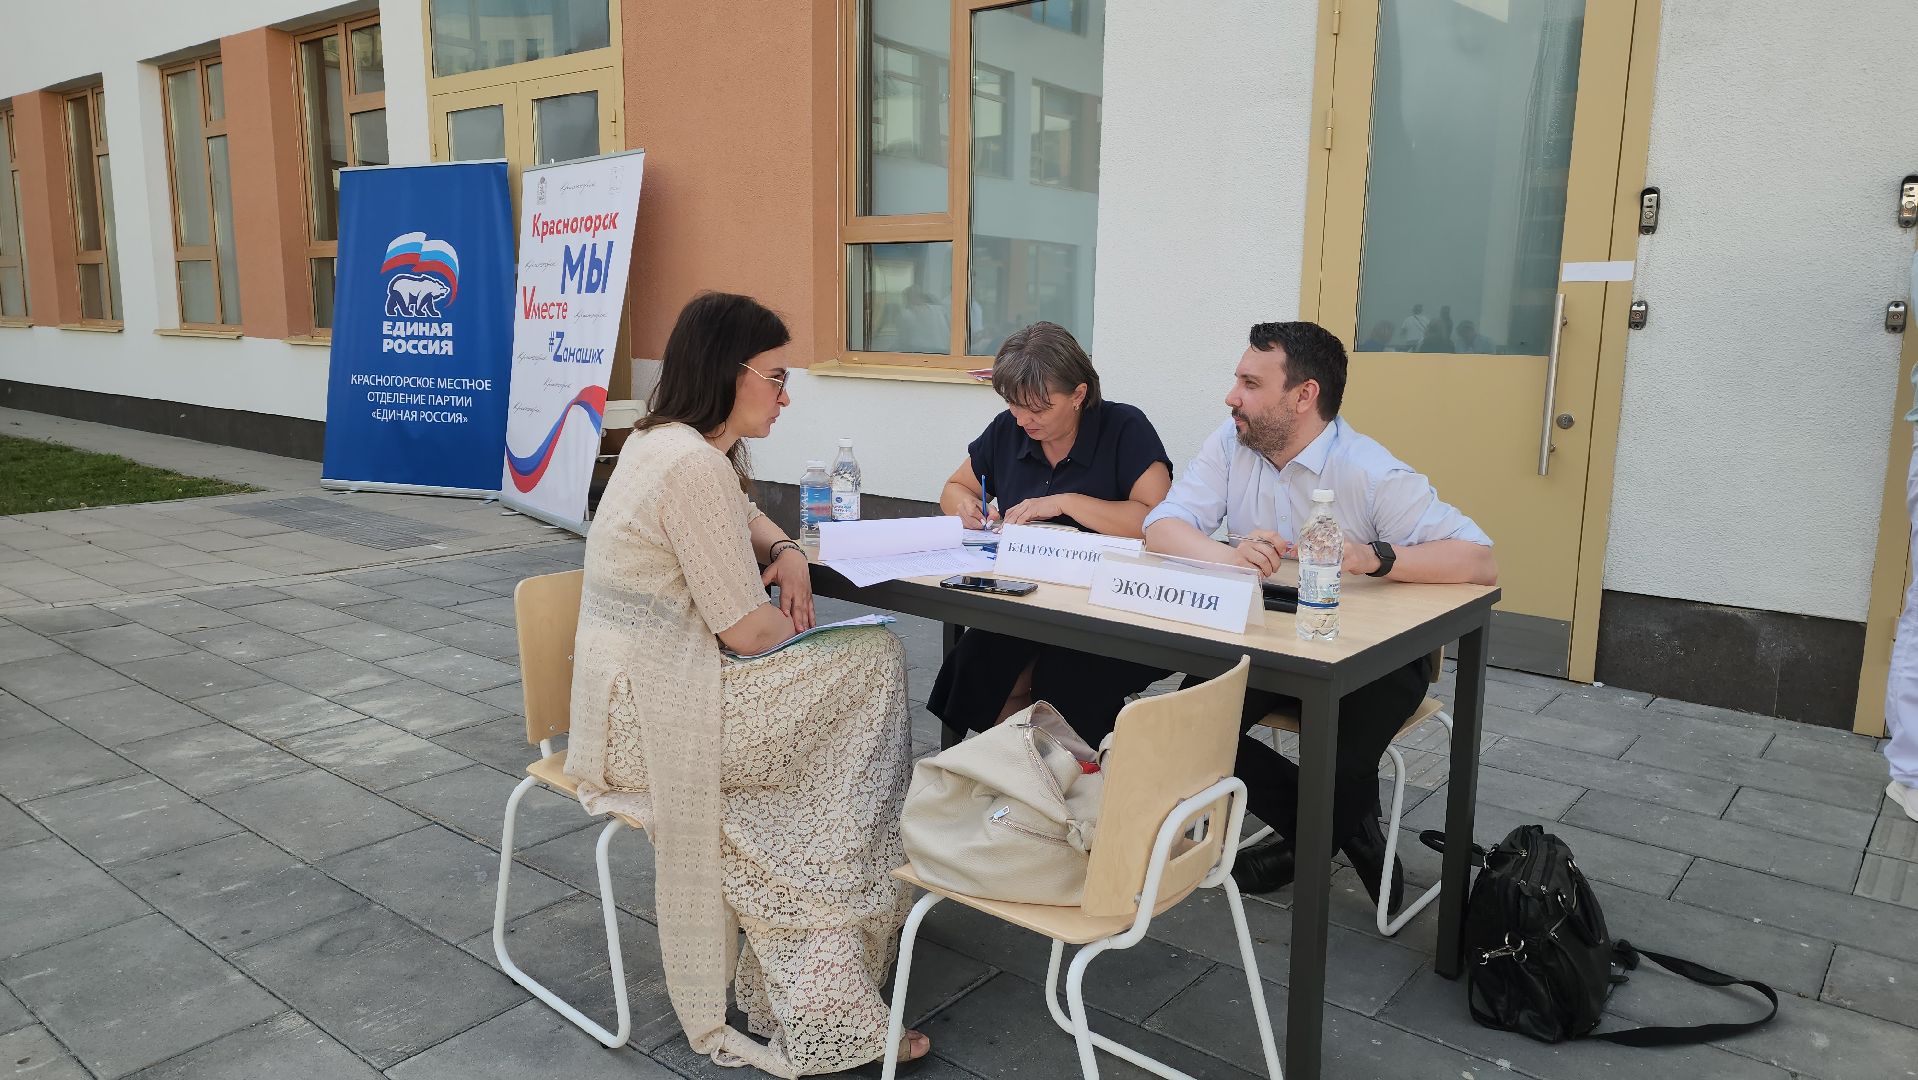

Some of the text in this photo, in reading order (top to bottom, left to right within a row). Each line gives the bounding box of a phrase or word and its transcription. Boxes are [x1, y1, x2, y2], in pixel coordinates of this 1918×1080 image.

[532, 212, 619, 243] Красногорск
[561, 241, 614, 294] МЫ
[522, 286, 568, 320] Vместе
[383, 321, 453, 338] ЕДИНАЯ
[383, 338, 453, 356] РОССИЯ
[350, 373, 492, 391] КРАСНОГОРСКОЕ МЕСТНОЕ
[367, 391, 472, 407] ОТДЕЛЕНИЕ ПАРТИИ
[371, 408, 468, 424] «ЕДИНАЯ РОССИЯ»
[1112, 577, 1220, 612] ЭКОЛОГИЯ
